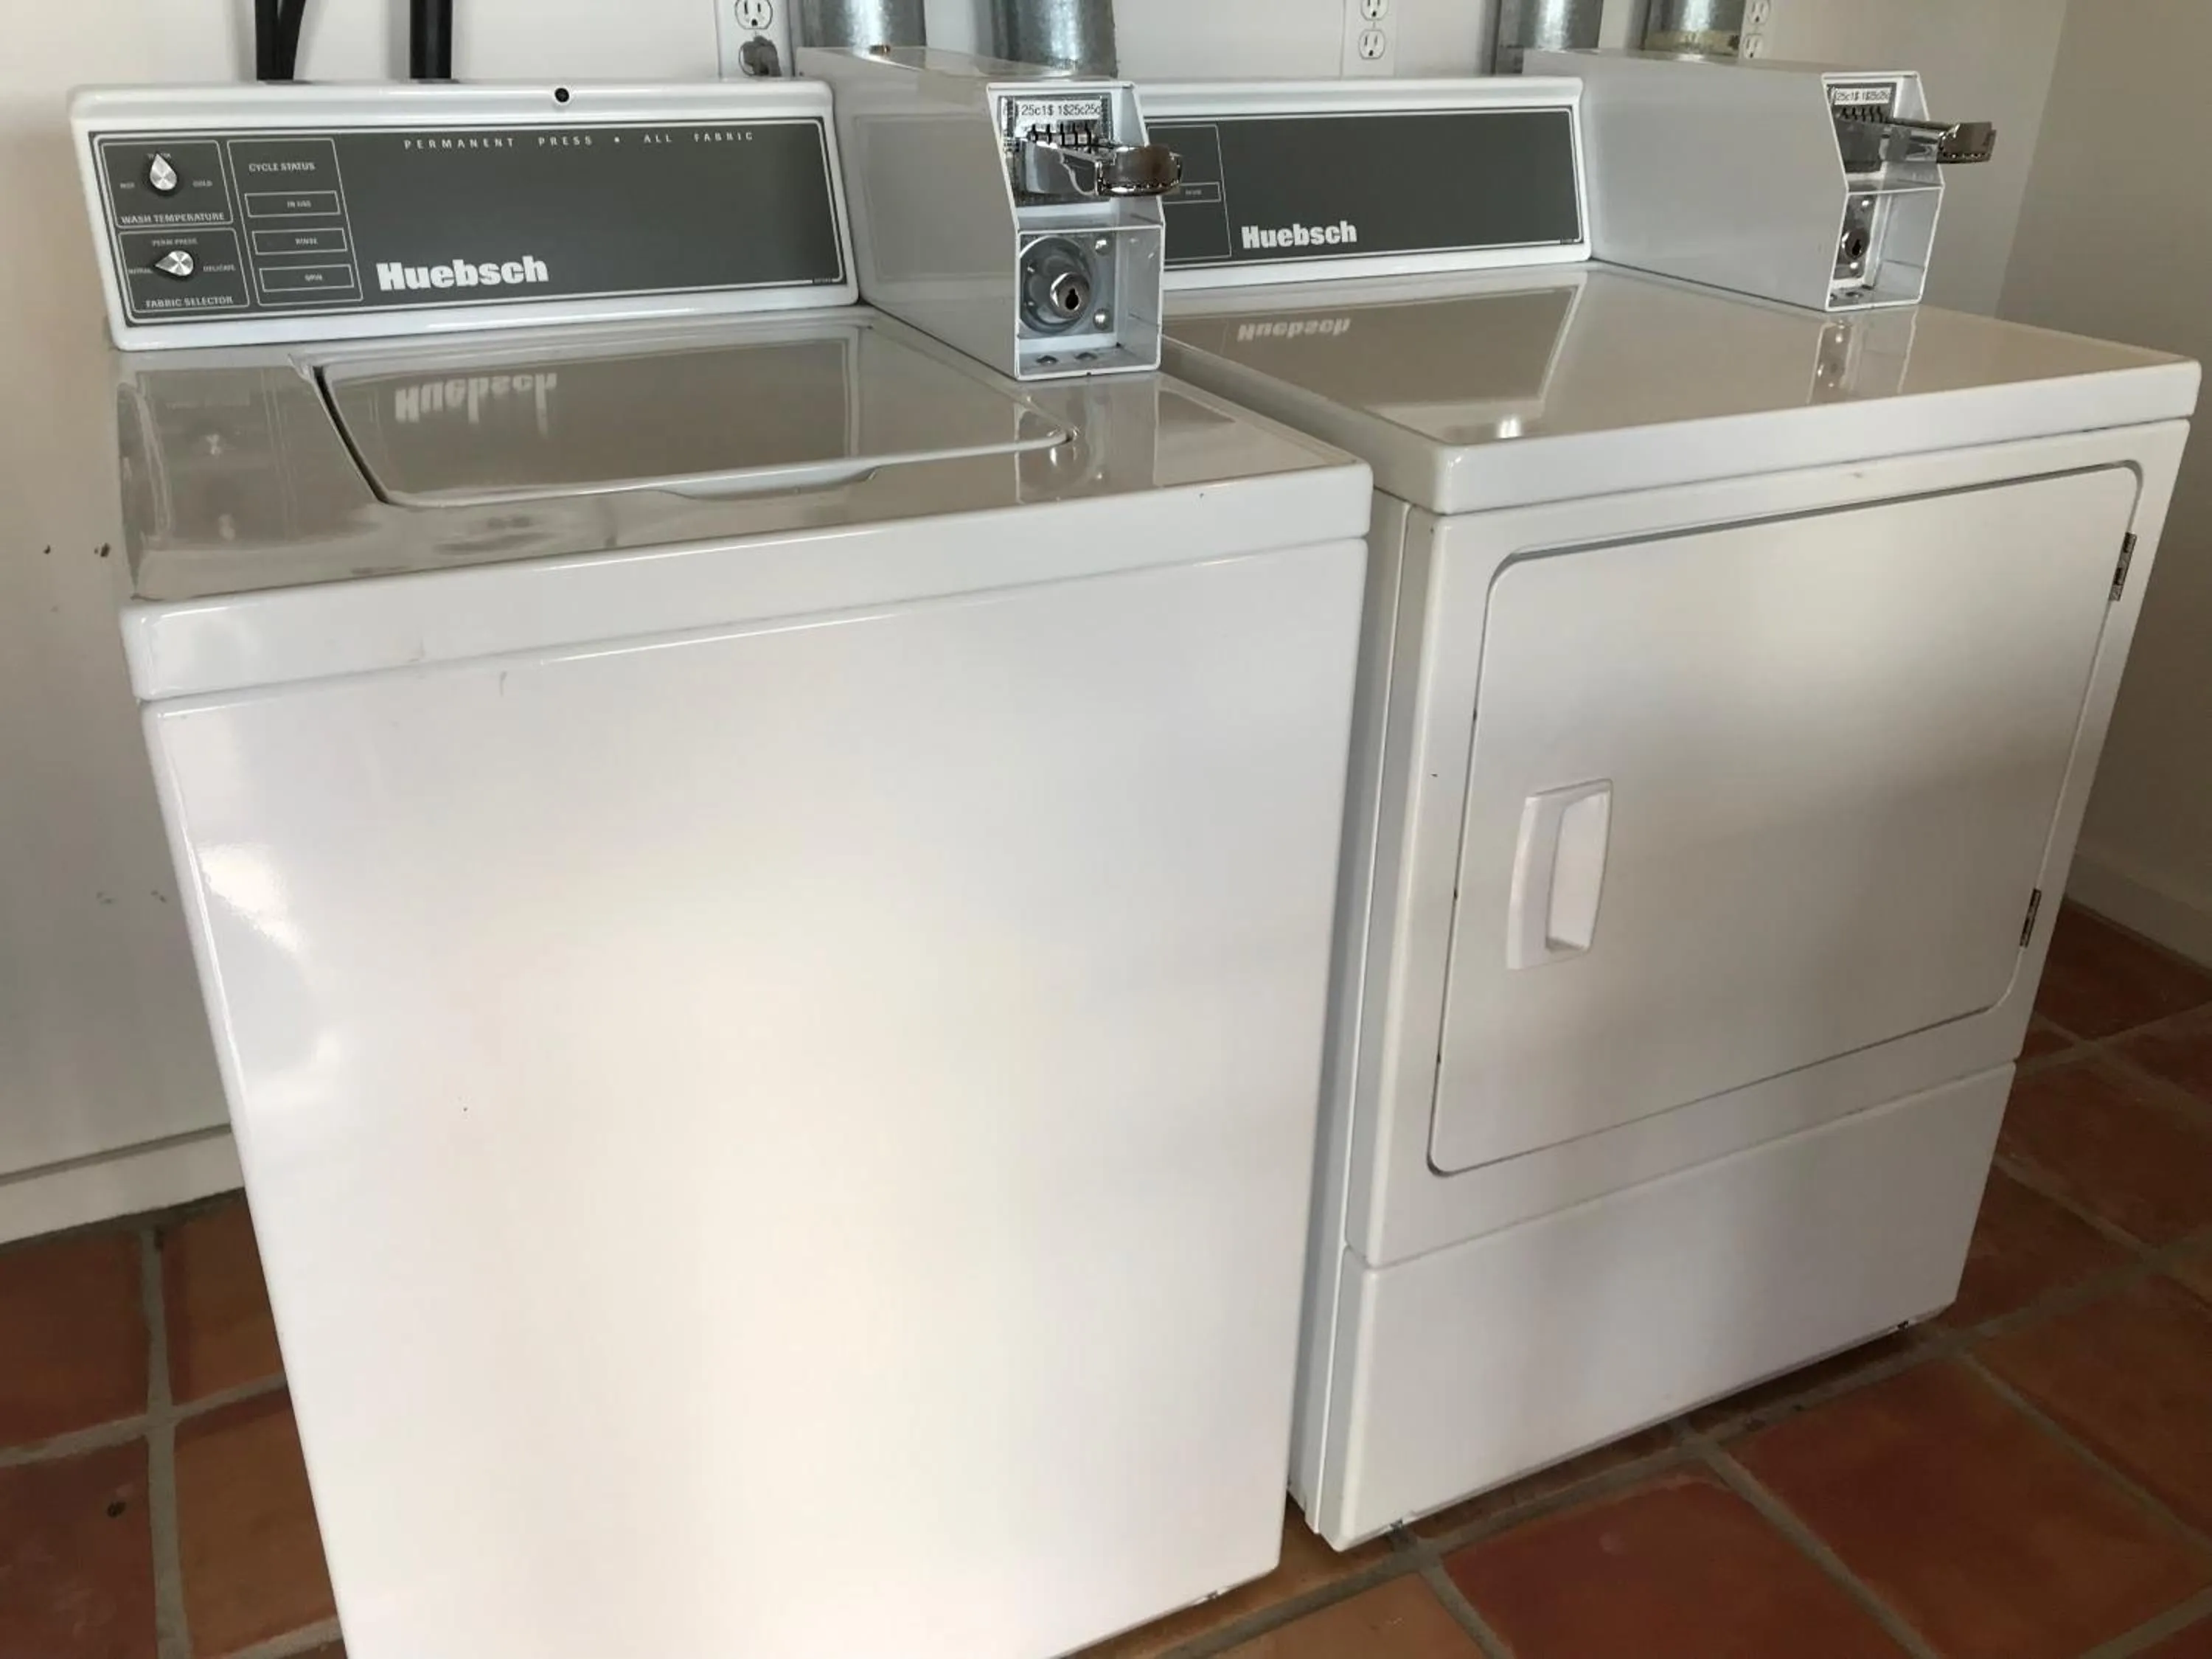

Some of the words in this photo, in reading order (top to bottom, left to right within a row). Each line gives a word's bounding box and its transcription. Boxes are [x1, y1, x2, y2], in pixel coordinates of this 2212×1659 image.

[404, 139, 515, 149] PERMANENT
[538, 136, 592, 145] PRESS
[643, 134, 672, 143] ALL
[694, 131, 754, 142] FABRIC
[248, 163, 279, 172] CYCLE
[280, 162, 316, 171] STATUS
[120, 215, 151, 224] WASH
[153, 212, 225, 223] TEMPERATURE
[1241, 221, 1357, 249] Huebsch
[376, 255, 549, 291] Huebsch
[146, 297, 184, 307] FABRIC
[184, 296, 234, 306] SELECTOR
